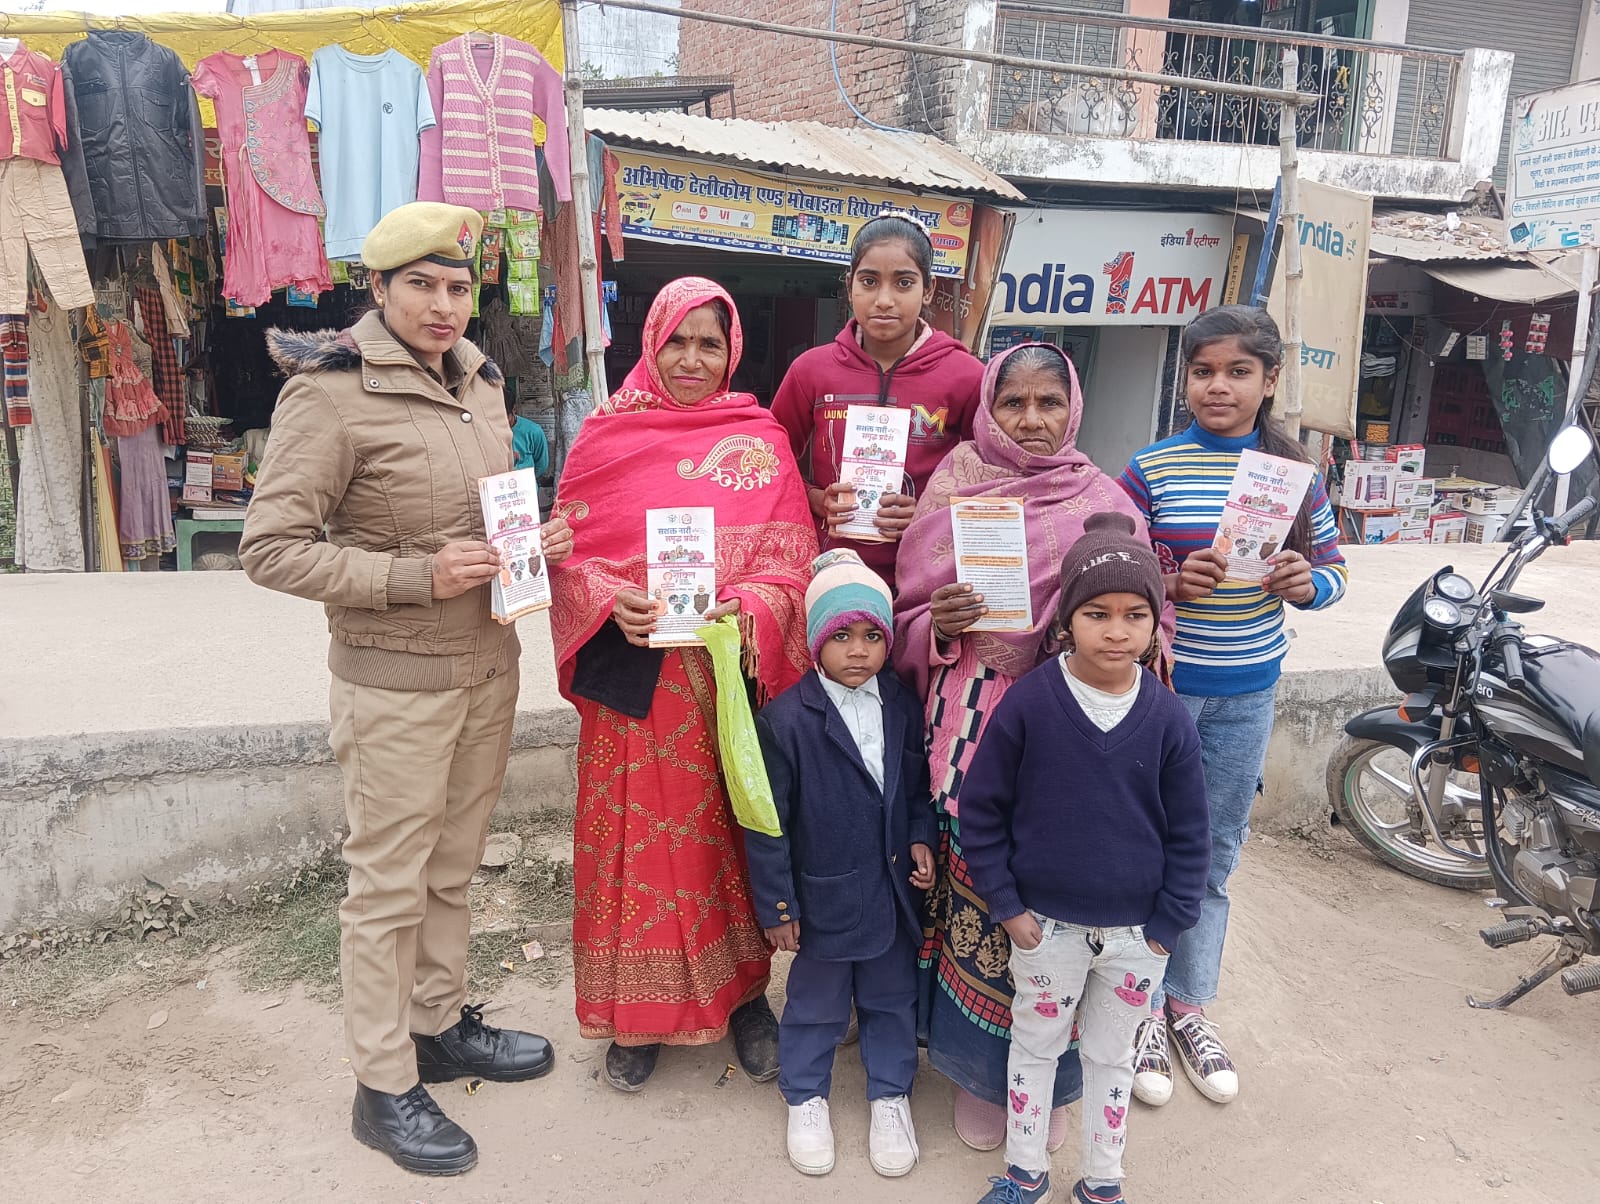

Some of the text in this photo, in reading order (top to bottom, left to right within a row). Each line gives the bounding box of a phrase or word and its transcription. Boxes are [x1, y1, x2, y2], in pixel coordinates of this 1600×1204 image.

[623, 165, 686, 192] अभिषेक
[757, 187, 787, 207] एण्ड
[788, 188, 844, 215] मोबाइल
[1000, 263, 1095, 314] ndia
[1130, 277, 1212, 315] ATM
[824, 409, 848, 420] LAUNC
[1476, 683, 1493, 698] ero
